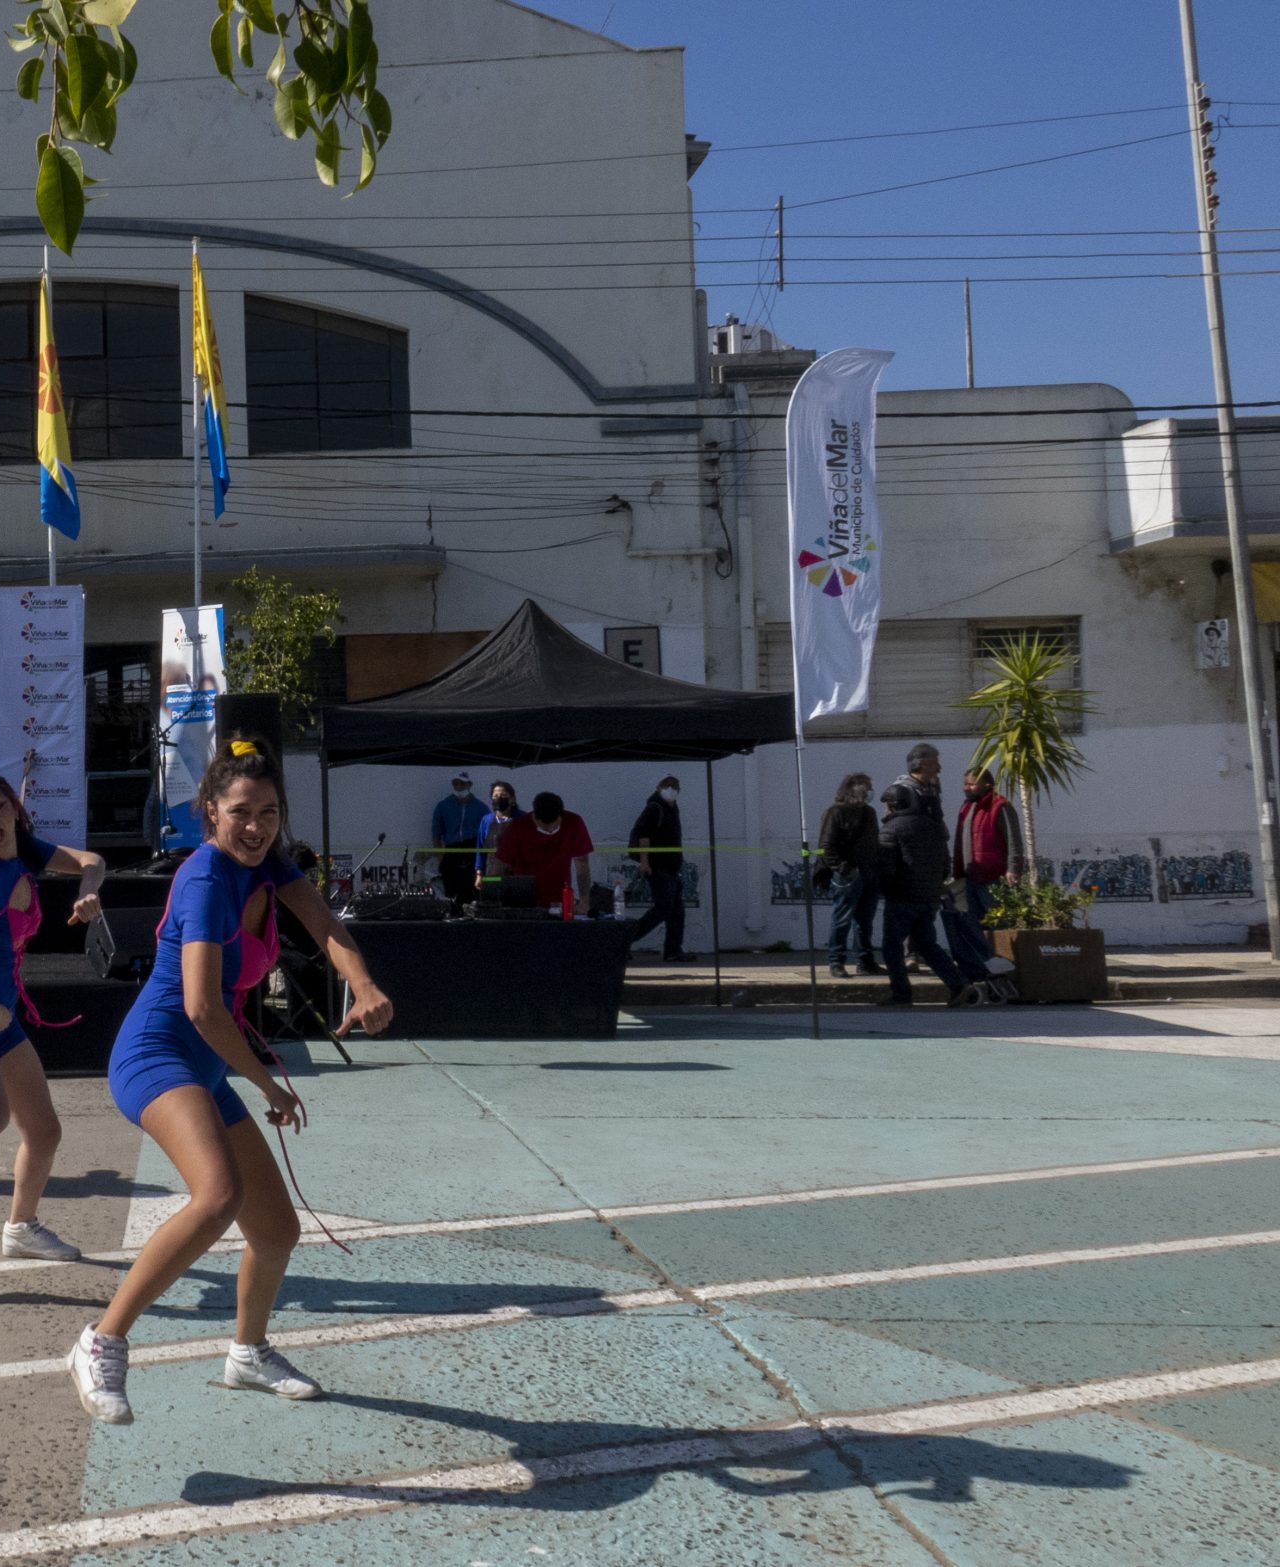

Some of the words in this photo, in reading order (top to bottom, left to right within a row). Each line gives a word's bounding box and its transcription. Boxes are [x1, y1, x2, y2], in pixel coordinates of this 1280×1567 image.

[850, 421, 863, 475] Cuidados
[825, 418, 850, 560] ViñadelMar
[851, 478, 862, 494] de
[851, 496, 864, 555] Municipio
[623, 640, 643, 668] E
